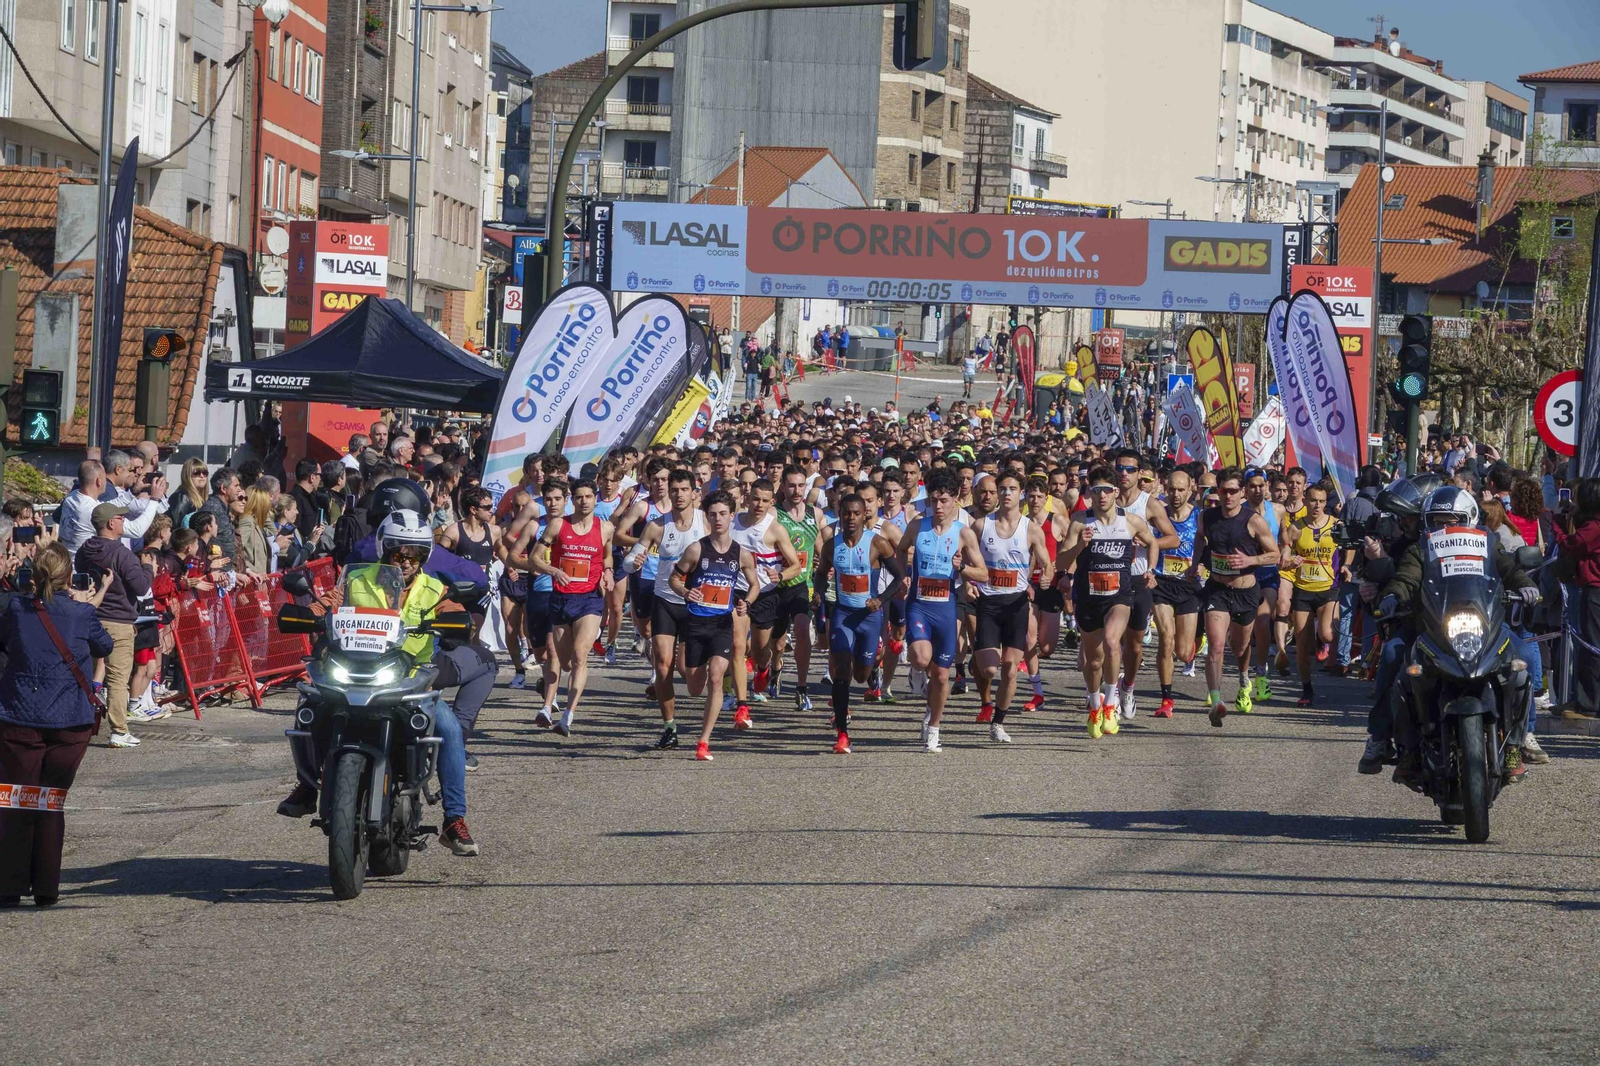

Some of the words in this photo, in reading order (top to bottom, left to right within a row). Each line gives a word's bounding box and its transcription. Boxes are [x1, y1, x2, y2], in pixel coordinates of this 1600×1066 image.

[650, 221, 740, 248] LASAL
[812, 218, 992, 260] PORRIÑO
[707, 248, 739, 257] cocinas
[1170, 240, 1268, 267] GADIS
[336, 260, 381, 276] LASAL
[1006, 264, 1099, 280] dezquilómetros
[867, 280, 952, 300] 00:00:05
[1326, 302, 1364, 317] ASAL
[288, 319, 308, 332] GADIS
[512, 396, 537, 422] O
[528, 302, 596, 398] Porriño
[586, 397, 611, 422] O
[600, 313, 670, 400] Porriño
[255, 375, 310, 386] CCNORTE
[1238, 376, 1249, 392] P.
[1553, 399, 1574, 427] 3
[334, 422, 366, 432] CEAMSA
[1430, 538, 1485, 551] ORGANIZACIÓN
[1172, 562, 1182, 572] 32
[1310, 566, 1319, 576] 114
[851, 582, 856, 592] 3
[993, 576, 1012, 587] 2001
[712, 594, 718, 604] 4
[355, 642, 382, 650] feminina
